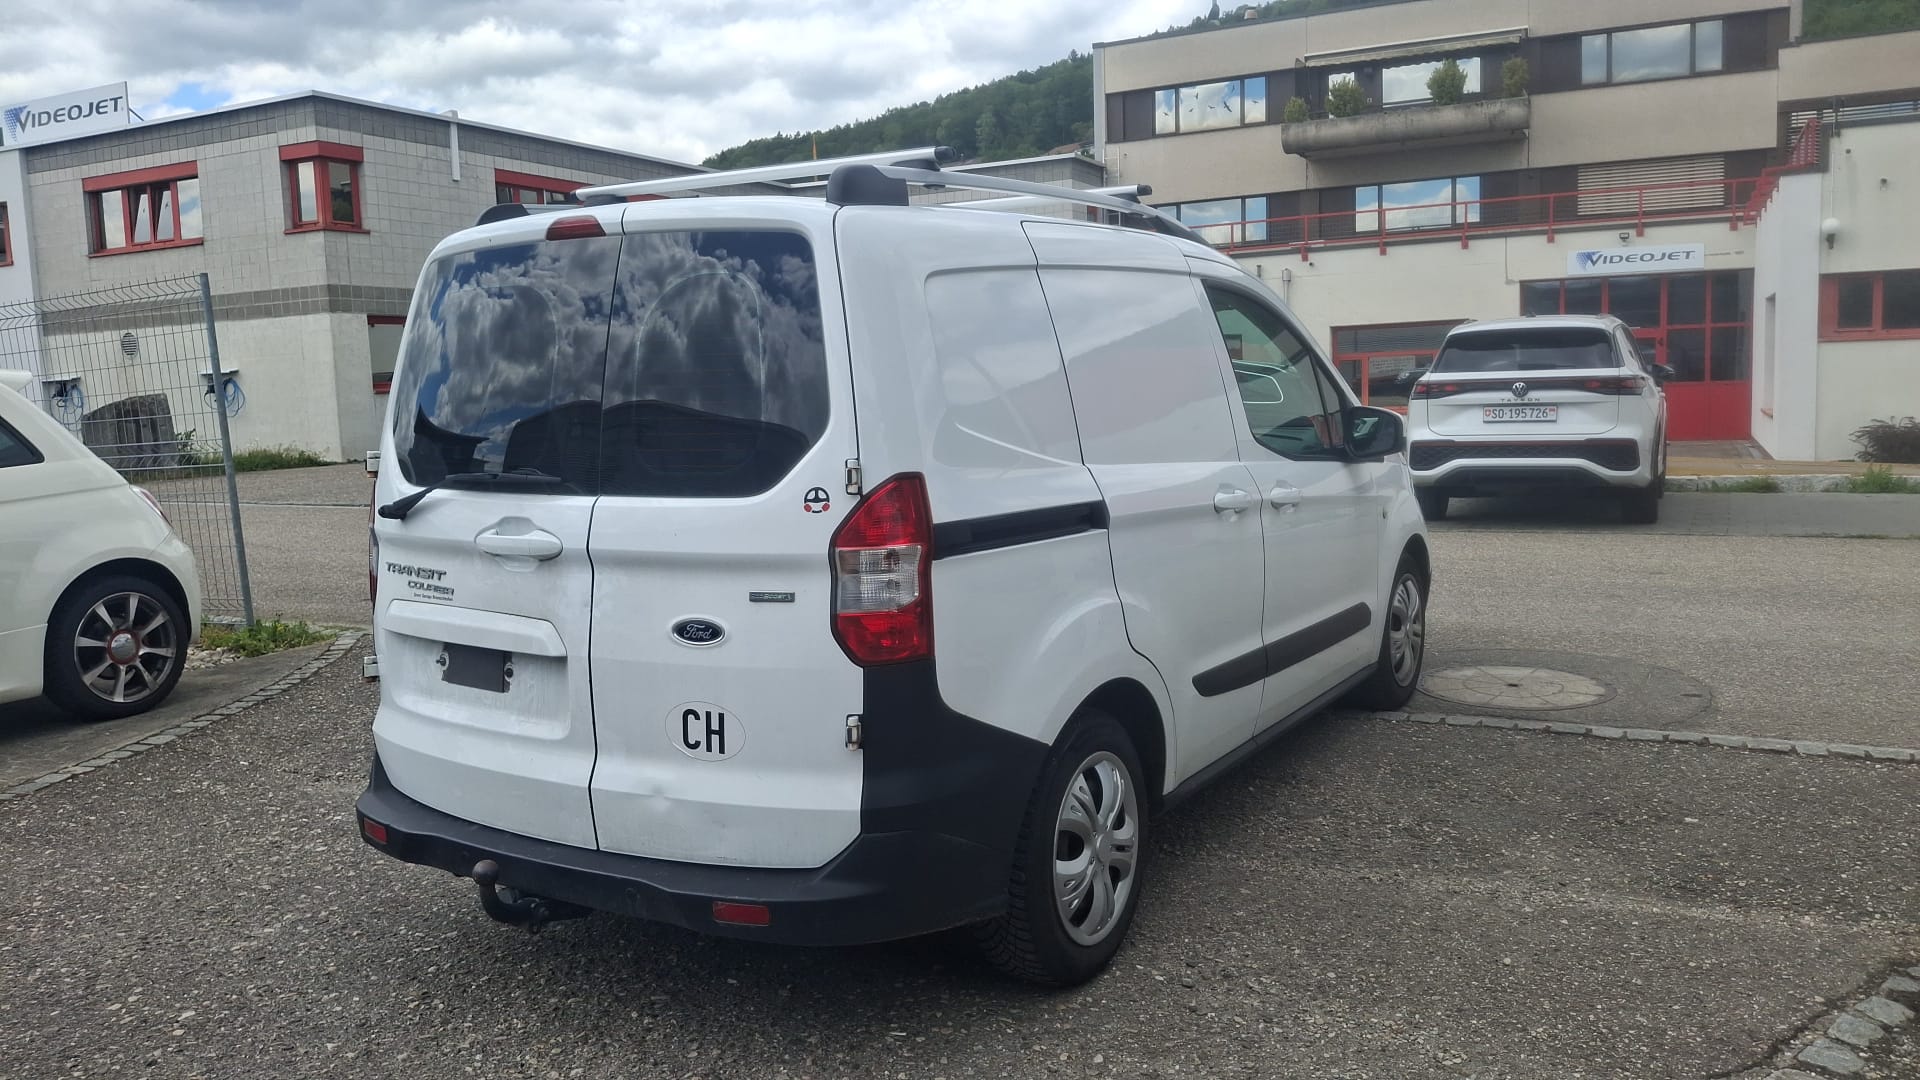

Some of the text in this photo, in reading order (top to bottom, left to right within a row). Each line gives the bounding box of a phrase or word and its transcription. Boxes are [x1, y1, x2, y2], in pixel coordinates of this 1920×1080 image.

[17, 96, 123, 133] VIDEOJET
[1588, 250, 1696, 267] VIDEOJET
[386, 561, 447, 581] TRANSIT
[683, 623, 713, 639] Ford
[682, 708, 726, 755] CH
